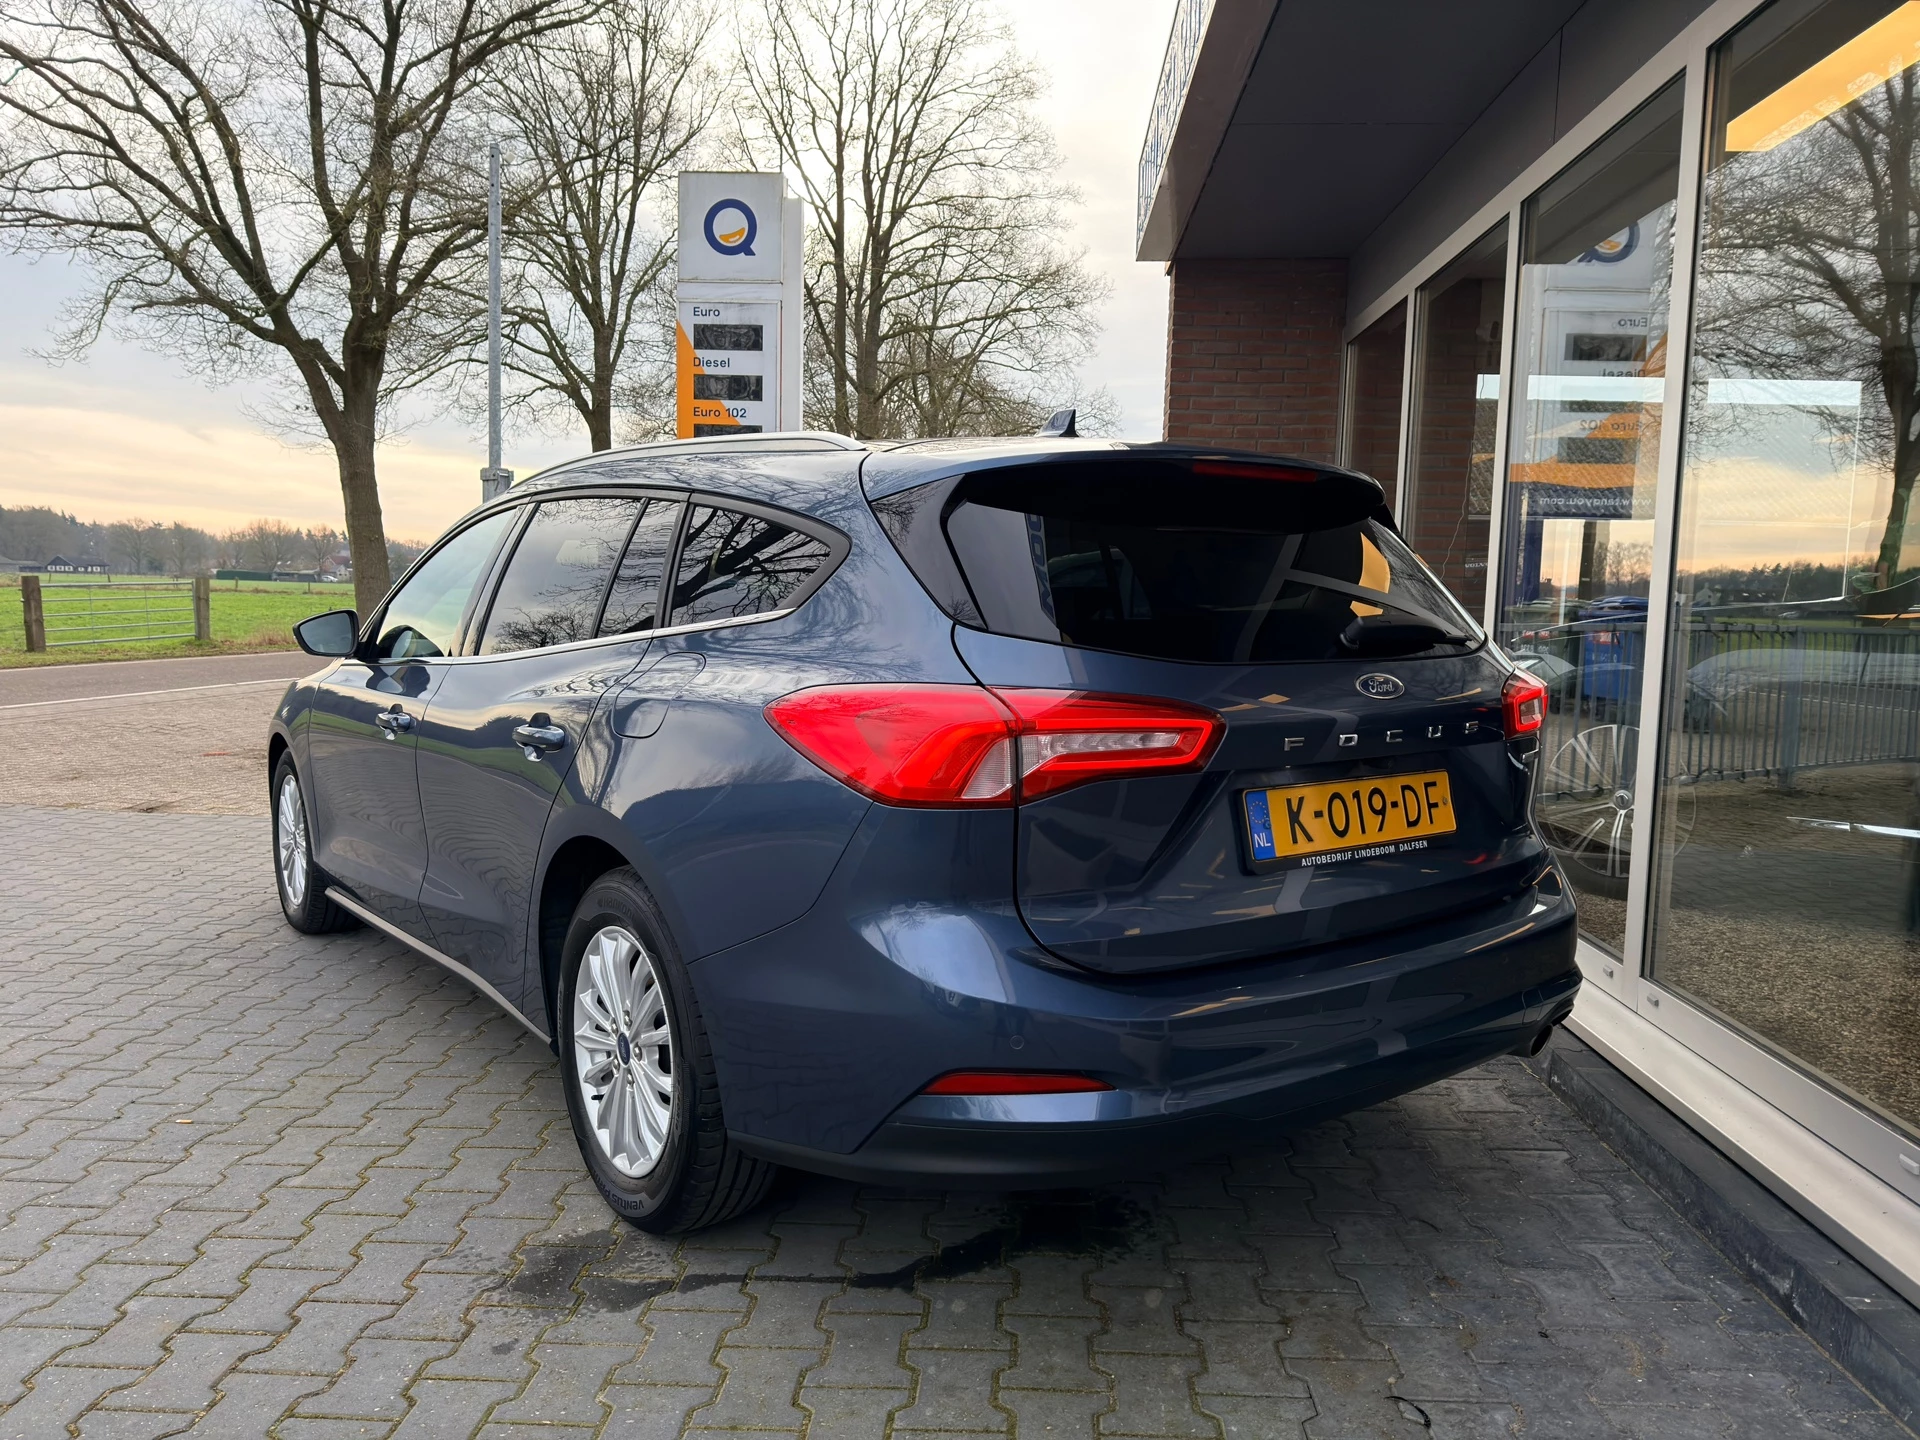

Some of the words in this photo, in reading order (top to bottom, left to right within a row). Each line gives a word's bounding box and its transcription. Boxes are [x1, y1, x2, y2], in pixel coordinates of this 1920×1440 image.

[703, 198, 757, 256] Q
[693, 306, 721, 317] Euro
[693, 356, 731, 368] Diesel
[693, 406, 721, 417] Euro
[725, 407, 747, 418] 102
[1284, 721, 1479, 751] FOCUS
[1286, 781, 1439, 845] K-019-DF
[1254, 832, 1271, 848] NL
[1301, 851, 1353, 867] AUTOBEDRIJF
[1354, 844, 1396, 859] LINDEBOOM
[1399, 839, 1428, 852] DALFSEN
